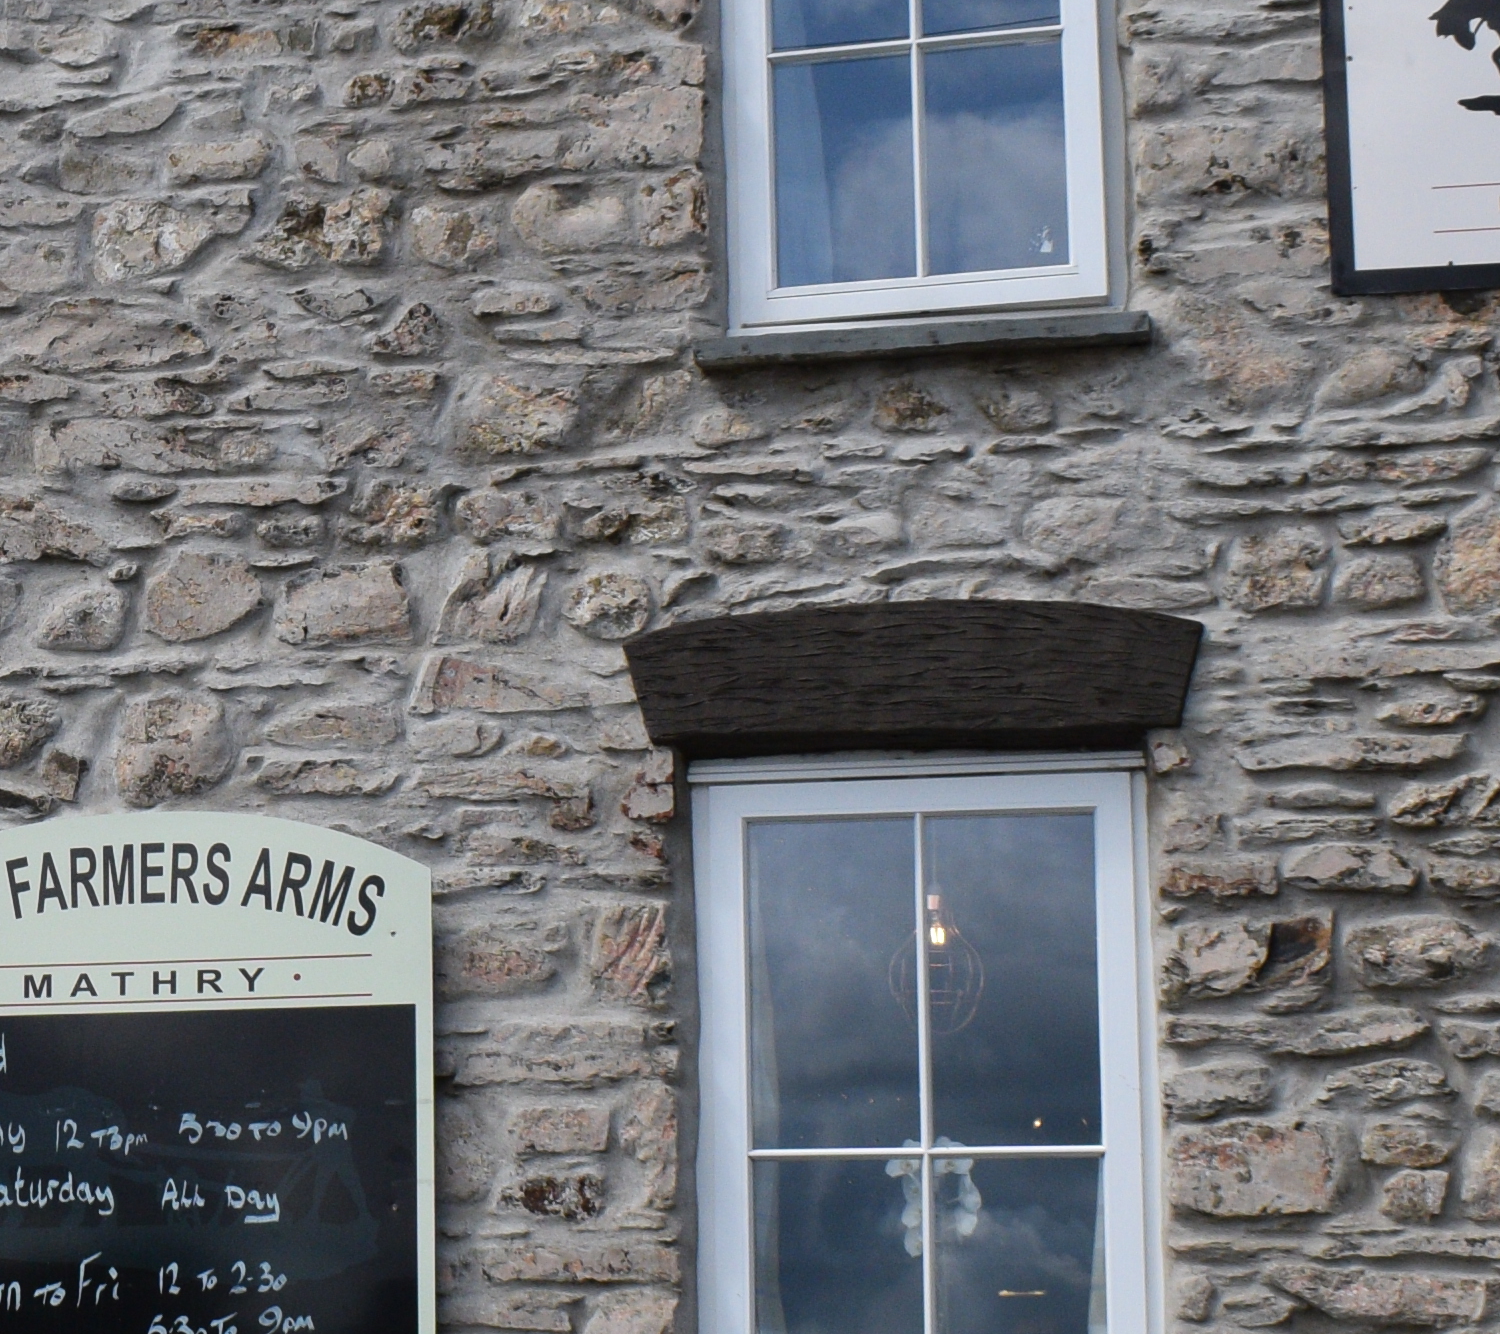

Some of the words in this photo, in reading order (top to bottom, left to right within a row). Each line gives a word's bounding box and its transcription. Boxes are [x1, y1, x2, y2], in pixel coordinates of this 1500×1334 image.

[7, 842, 230, 919] FARMERS
[241, 847, 386, 936] ARMS
[23, 968, 265, 999] MATHRY
[56, 1119, 85, 1152] 12
[77, 1251, 120, 1308] Fri
[159, 1261, 181, 1295] 12
